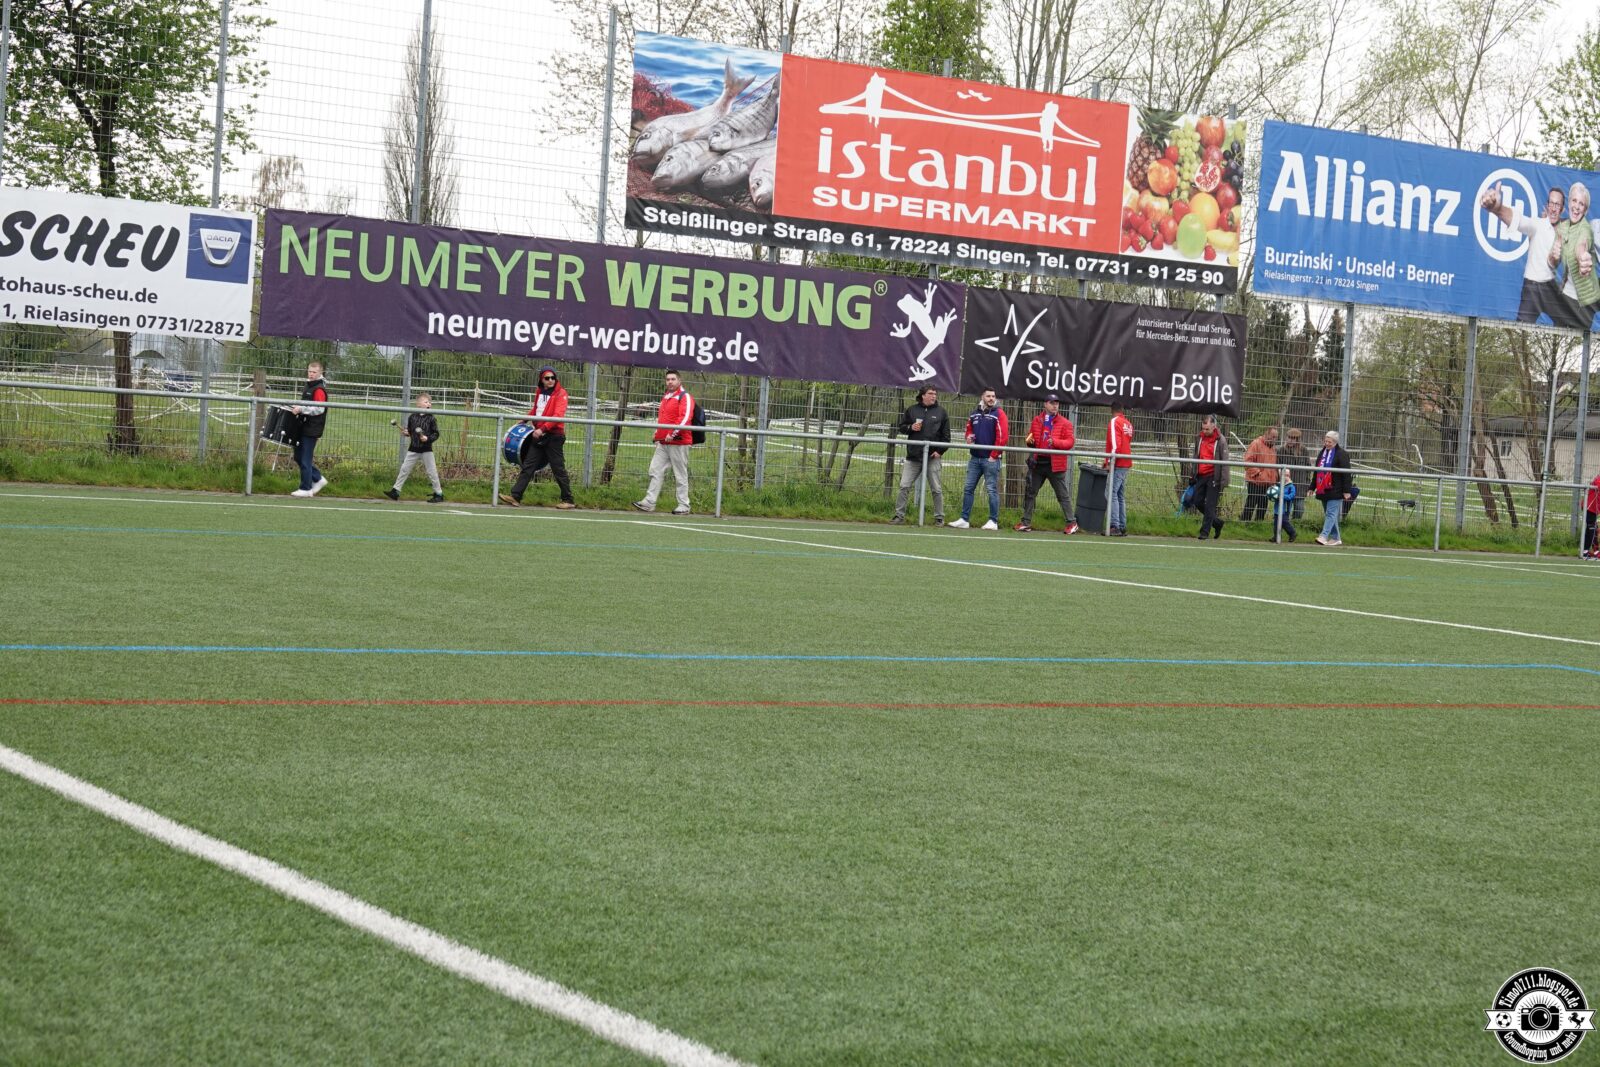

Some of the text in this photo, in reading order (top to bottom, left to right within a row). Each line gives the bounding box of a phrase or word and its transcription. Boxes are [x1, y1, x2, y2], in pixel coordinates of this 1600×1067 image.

[816, 127, 1097, 206] istanbul
[812, 186, 1097, 237] SUPERMARKT
[1268, 150, 1461, 236] Allianz
[0, 210, 181, 272] SCHEU
[206, 234, 234, 243] DACIA
[643, 206, 765, 236] Steißlinger
[773, 222, 844, 245] Straße
[850, 231, 882, 251] 61,
[889, 236, 950, 256] 78224
[956, 243, 1031, 267] Singen,
[1037, 252, 1069, 269] Tel.
[1075, 256, 1130, 275] 07731
[1148, 266, 1168, 279] 91
[1175, 268, 1197, 282] 25
[1202, 271, 1224, 286] 90
[279, 224, 586, 303] NEUMEYER
[605, 259, 871, 330] WERBUNG
[1264, 269, 1379, 292] Rielasingerstr. 21 in 78224 Singen
[1265, 246, 1334, 271] Burzinski
[1345, 256, 1396, 279] Unseld
[1407, 264, 1455, 286] Berner
[24, 304, 130, 328] Rielasingen
[136, 314, 245, 337] 07731/22872
[428, 311, 759, 365] neumeyer-werbung.de
[1135, 329, 1237, 347] für Mercedes-Benz, smart und AMG.
[1136, 318, 1231, 335] Autorisierter Verkauf und Service
[1025, 359, 1144, 398] Südstern
[1170, 373, 1232, 404] Bölle
